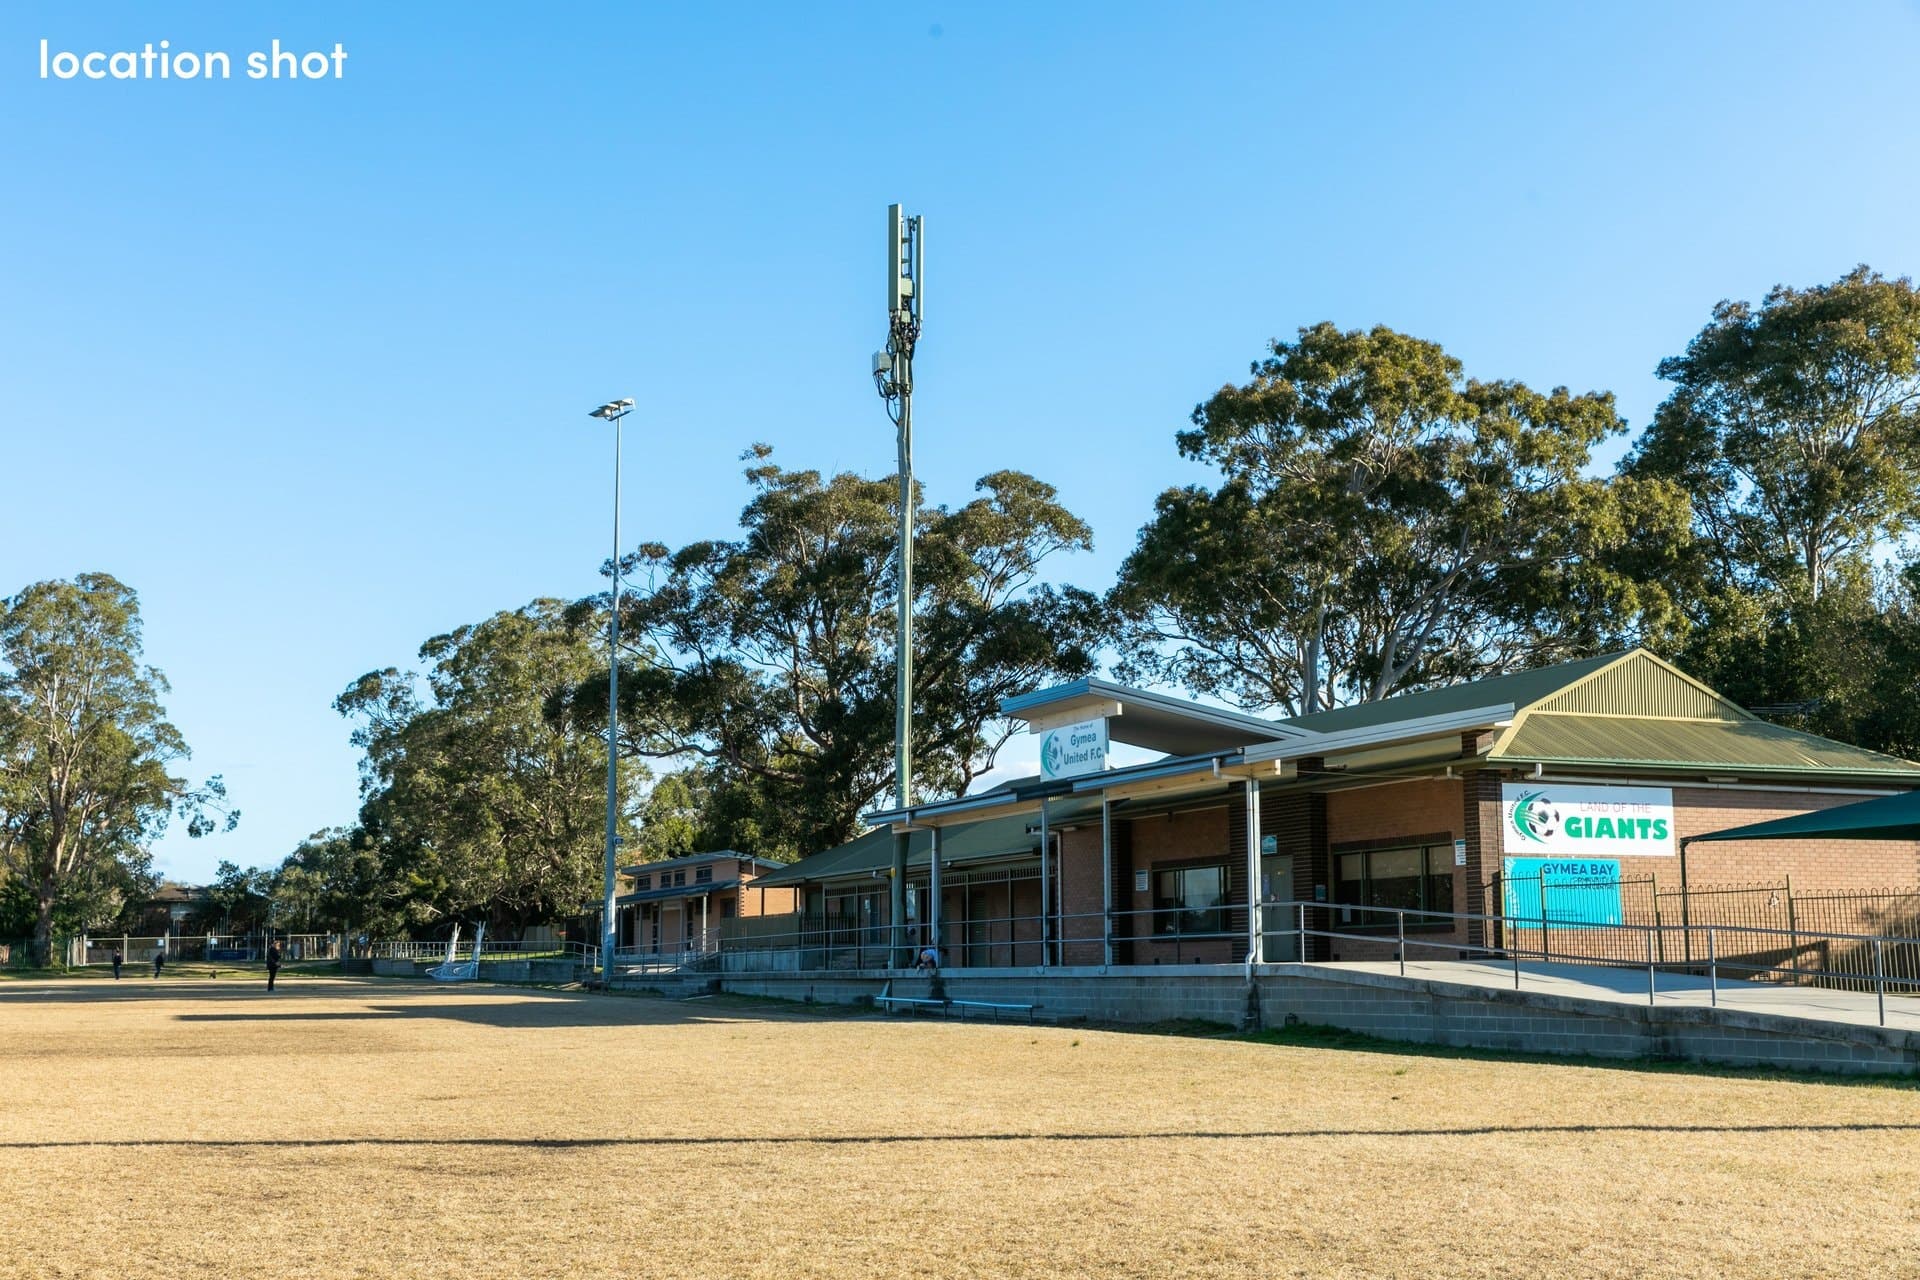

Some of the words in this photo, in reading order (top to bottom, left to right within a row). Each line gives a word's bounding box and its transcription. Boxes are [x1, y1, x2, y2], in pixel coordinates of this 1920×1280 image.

[1070, 733, 1097, 748] Gymea
[1064, 749, 1088, 765] United
[1090, 747, 1105, 760] F.C.
[1580, 801, 1609, 812] LAND
[1613, 802, 1625, 813] OF
[1631, 802, 1652, 814] THE
[1564, 816, 1669, 841] GIANTS
[1543, 863, 1588, 875] GYMEA
[1590, 863, 1615, 876] BAY
